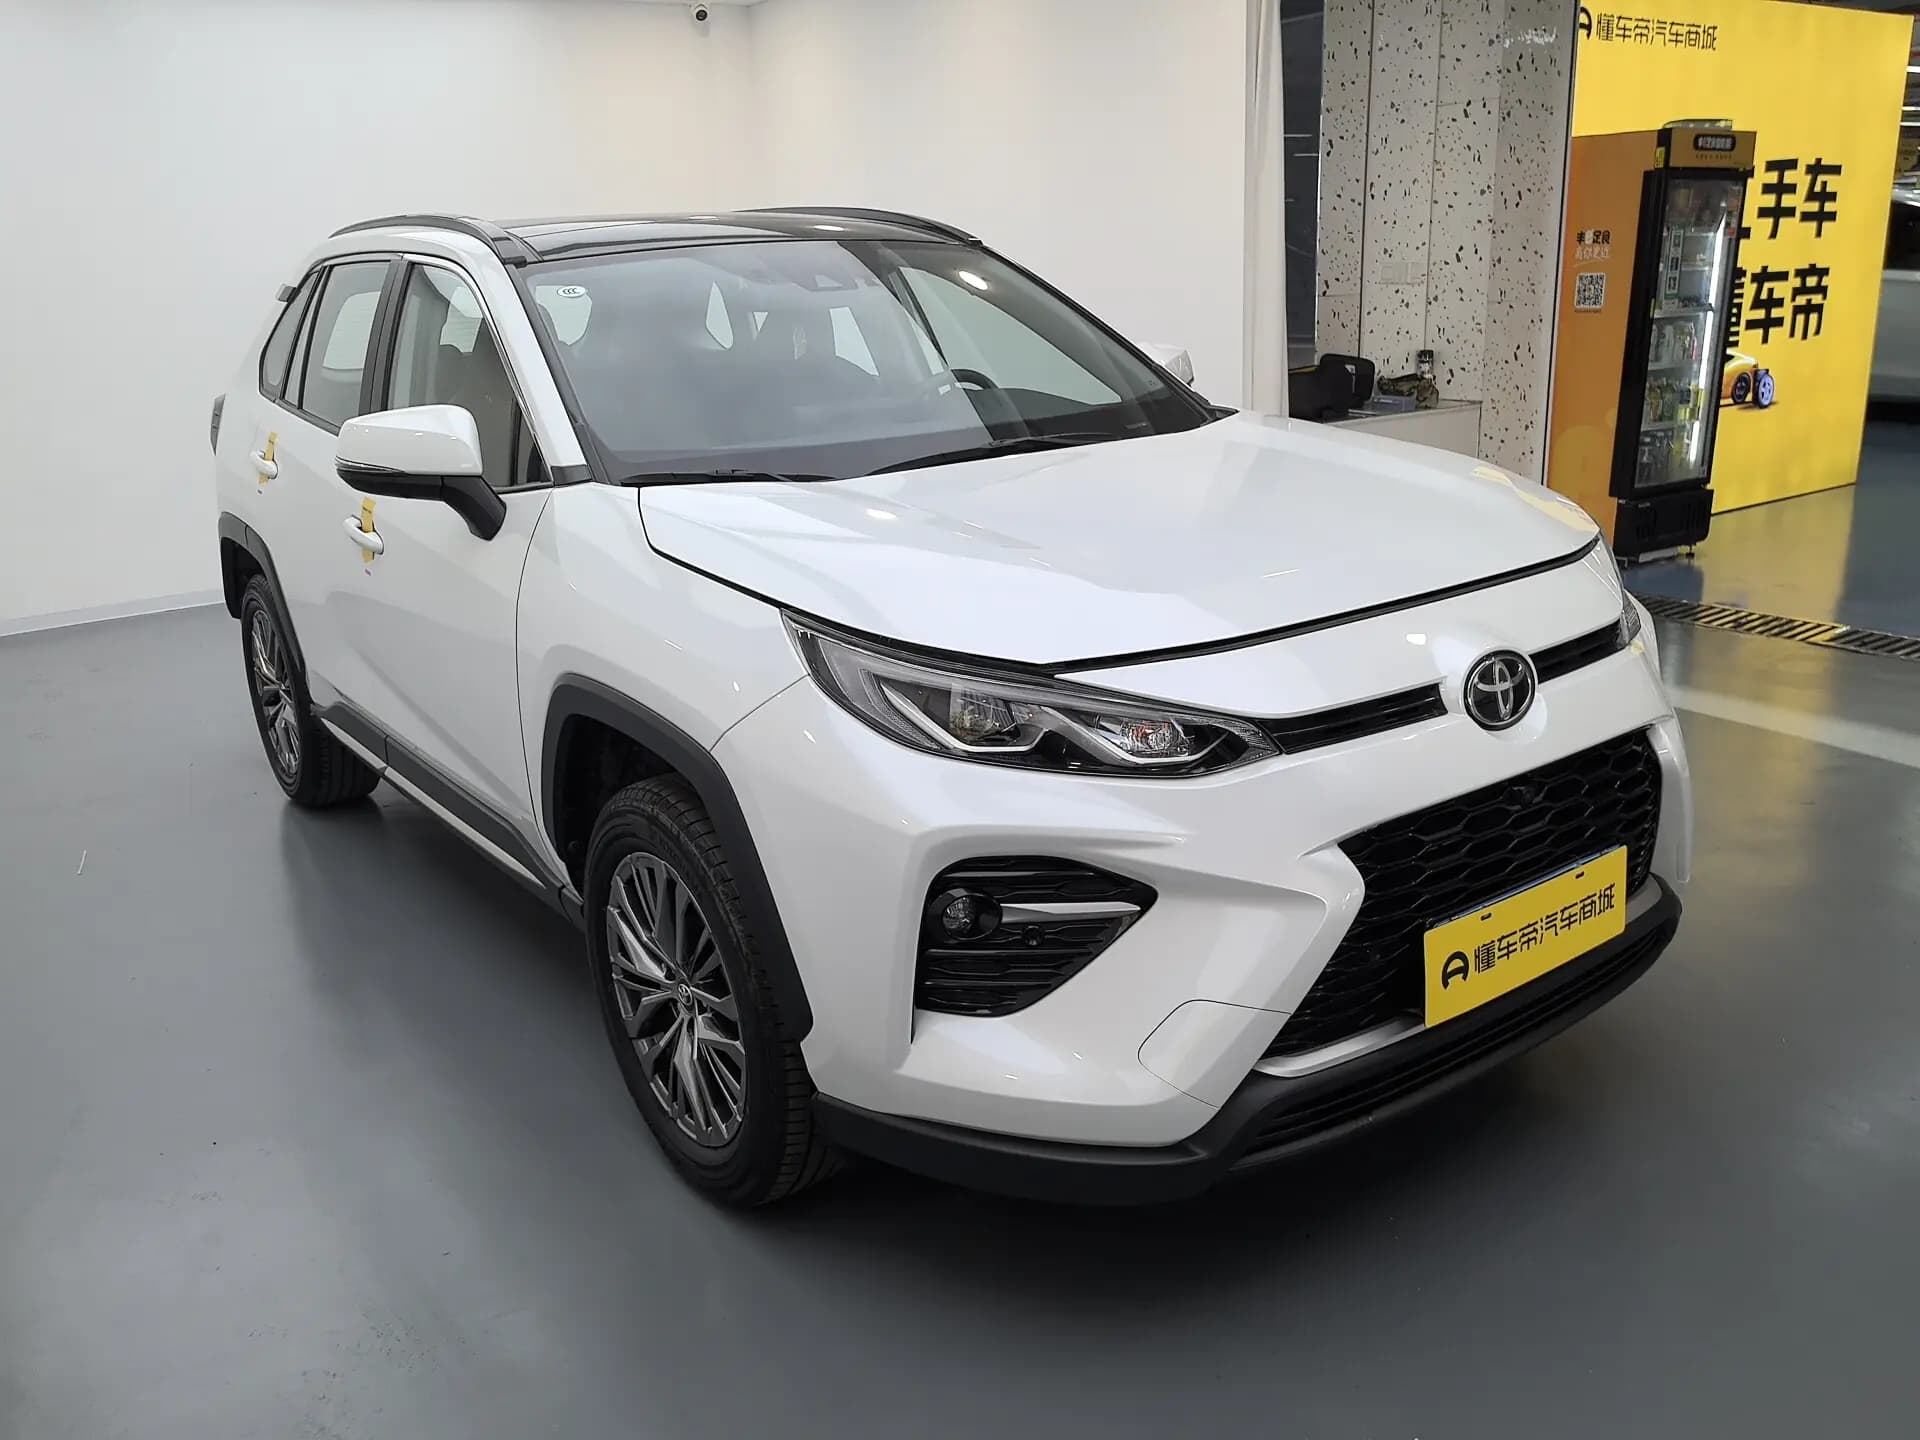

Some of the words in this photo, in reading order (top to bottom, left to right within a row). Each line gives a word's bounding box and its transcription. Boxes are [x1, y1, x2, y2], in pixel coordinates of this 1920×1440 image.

[1596, 13, 1718, 51] 懂车帝汽车商城
[1740, 158, 1843, 239] 手车
[1474, 882, 1616, 974] 懂车帝汽车商城
